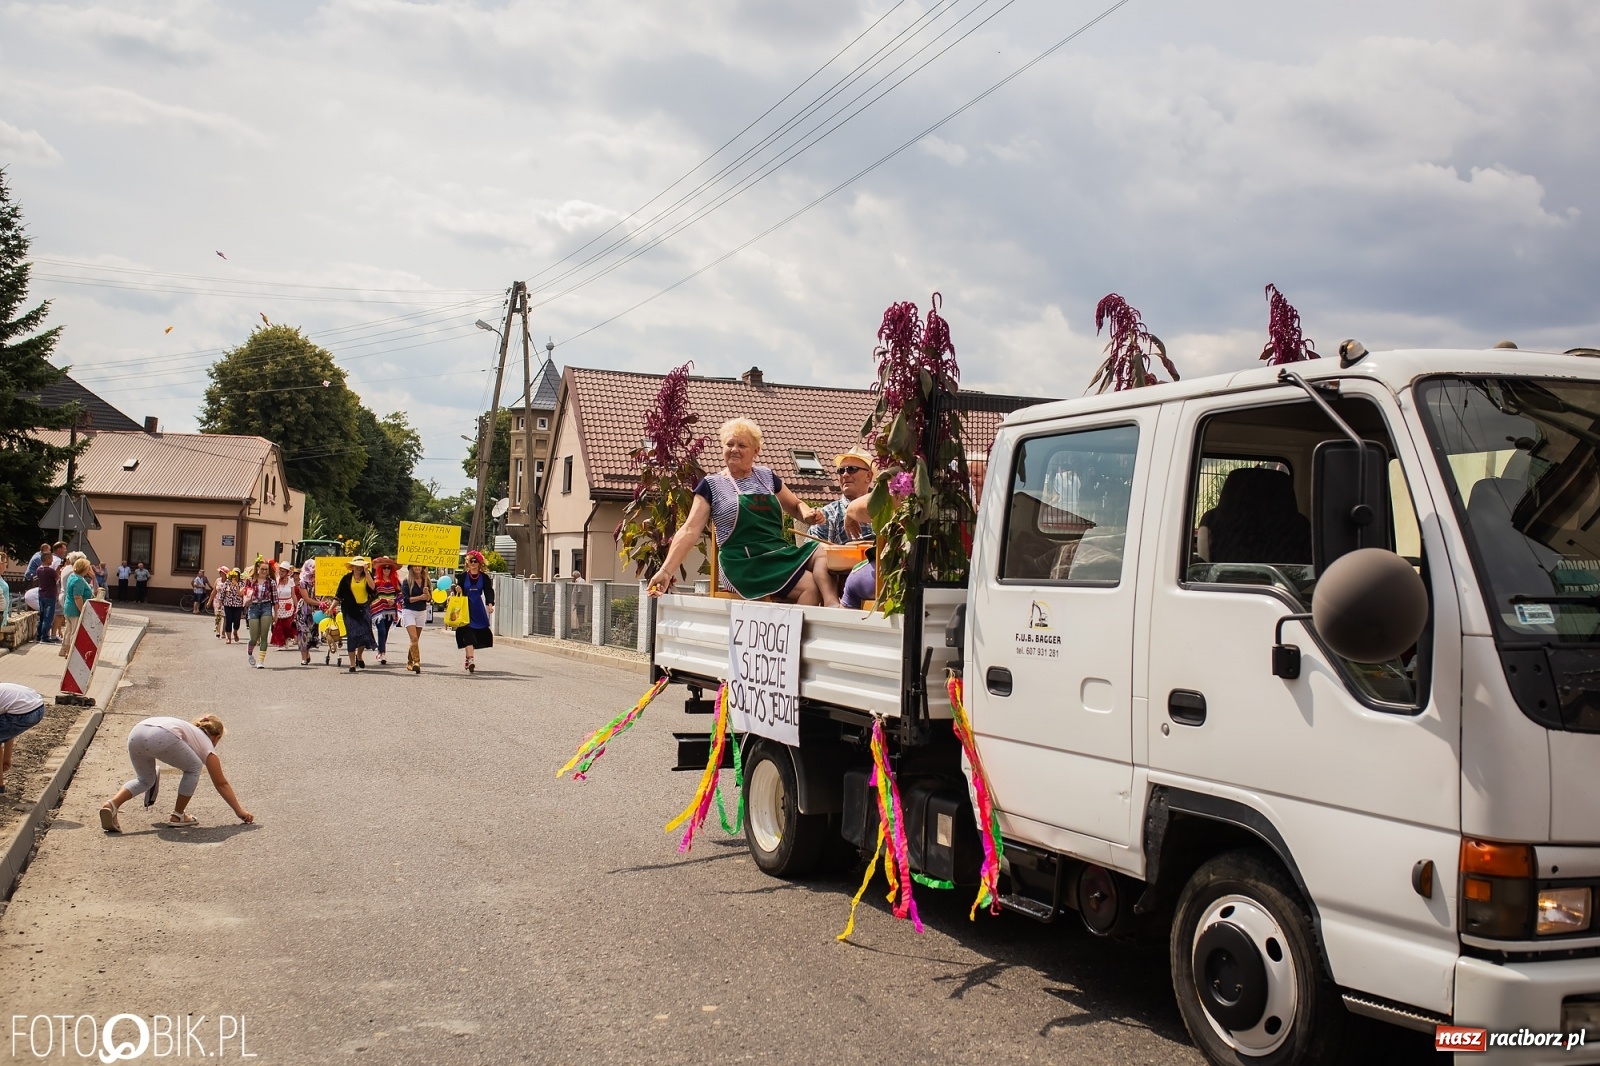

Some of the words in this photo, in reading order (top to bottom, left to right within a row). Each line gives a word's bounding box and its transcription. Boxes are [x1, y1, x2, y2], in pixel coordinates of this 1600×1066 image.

[407, 523, 451, 533] LEWIATAN
[399, 545, 405, 553] A
[733, 619, 744, 646] Z
[748, 620, 790, 655] DROGI
[1015, 633, 1034, 642] F.U.B.
[1035, 634, 1061, 644] BAGGER
[1026, 647, 1036, 655] 607
[1037, 647, 1047, 656] 931
[1049, 648, 1059, 657] 281
[768, 691, 800, 727] JEDZIE
